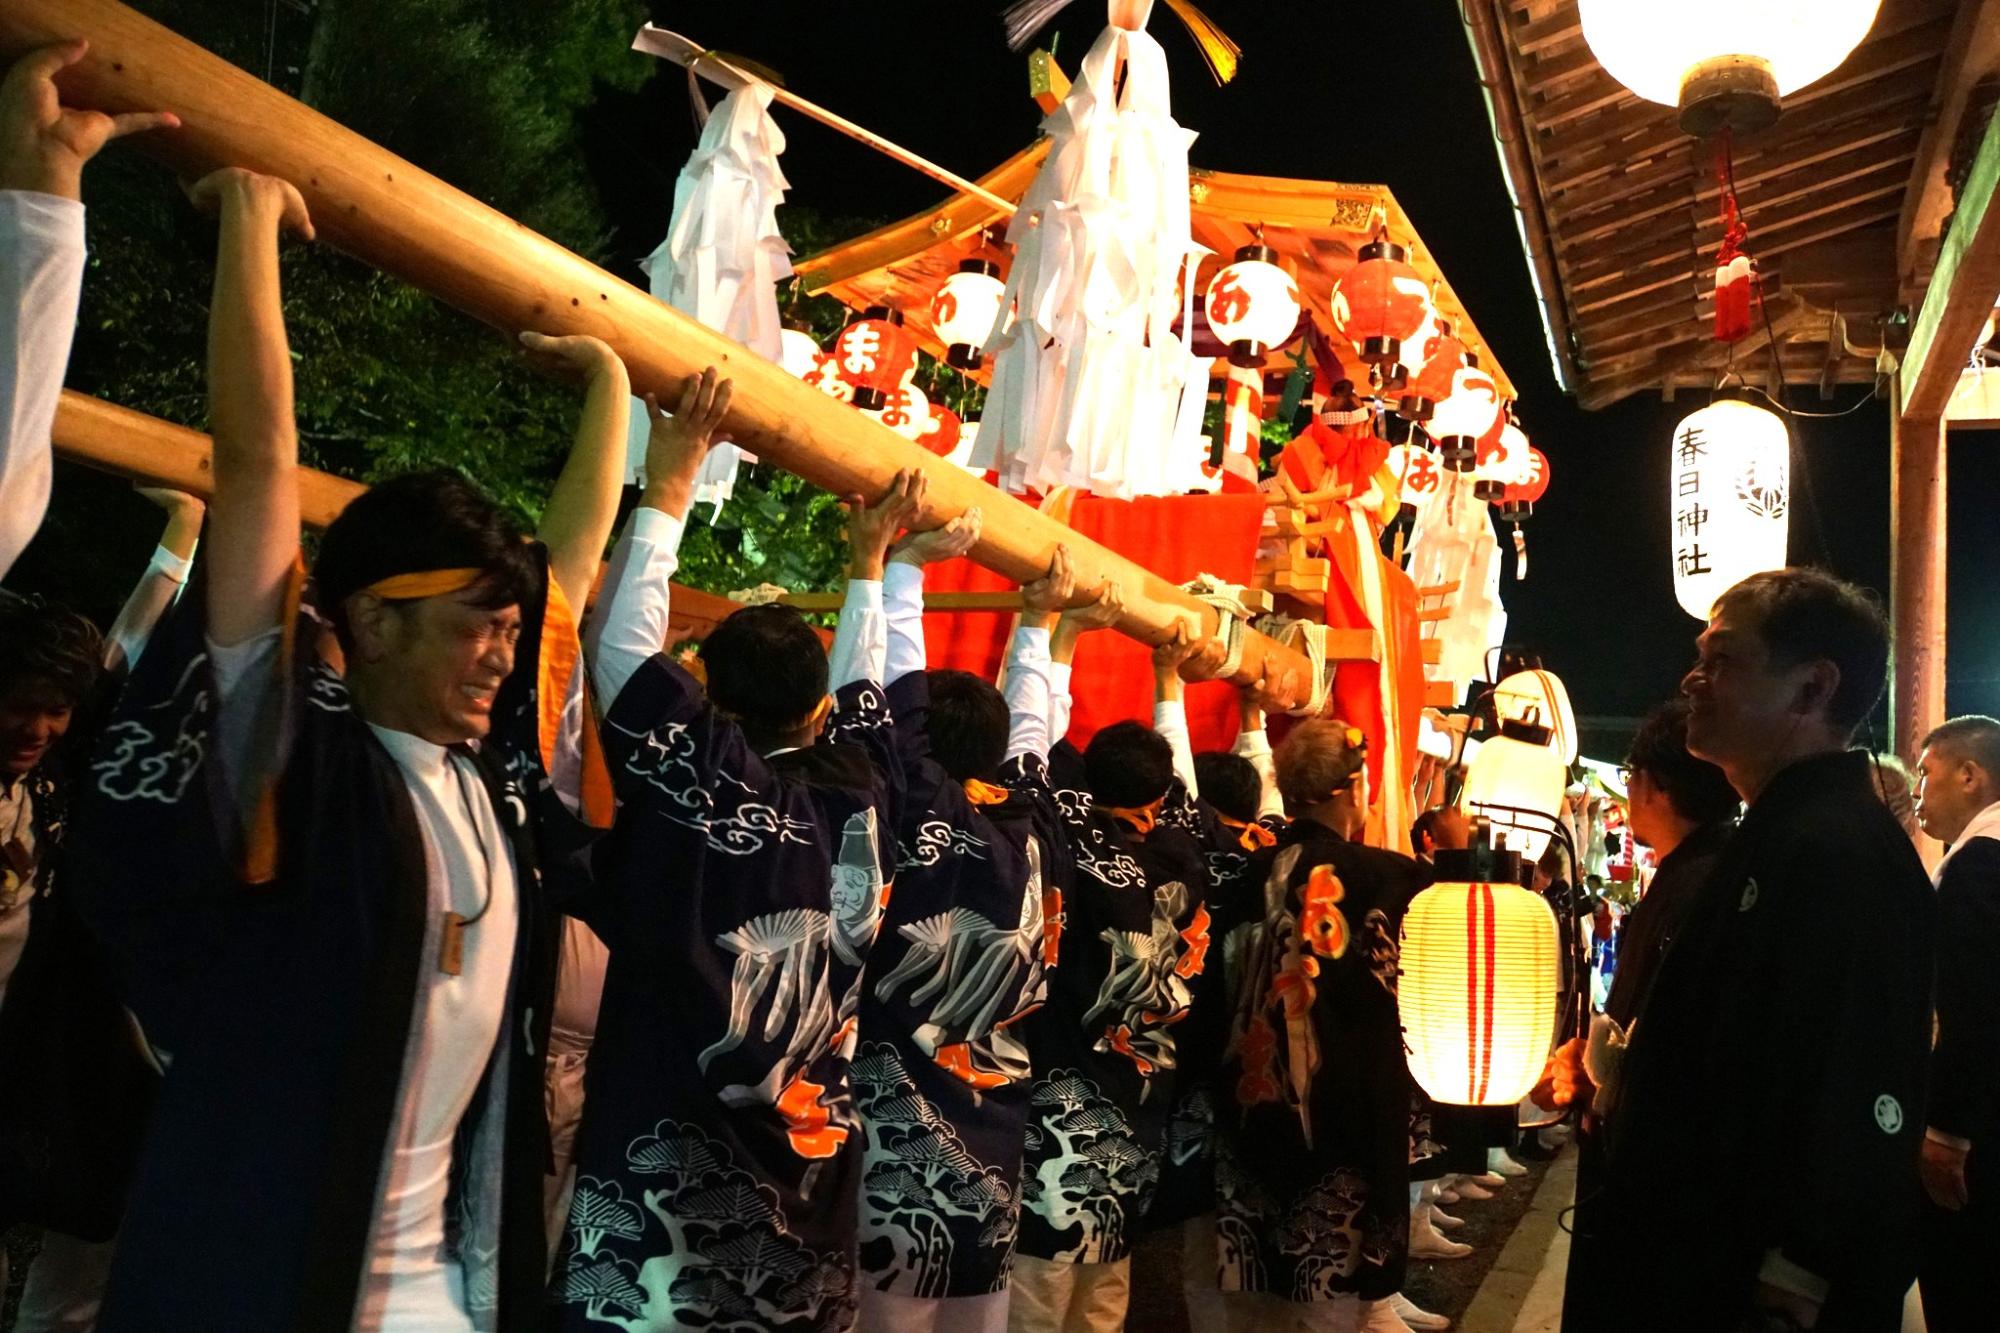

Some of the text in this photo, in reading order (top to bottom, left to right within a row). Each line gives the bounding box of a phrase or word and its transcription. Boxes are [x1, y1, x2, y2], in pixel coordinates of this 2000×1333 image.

[843, 323, 880, 374] ま
[1407, 453, 1439, 493] あ
[1677, 427, 1712, 578] 春日神社
